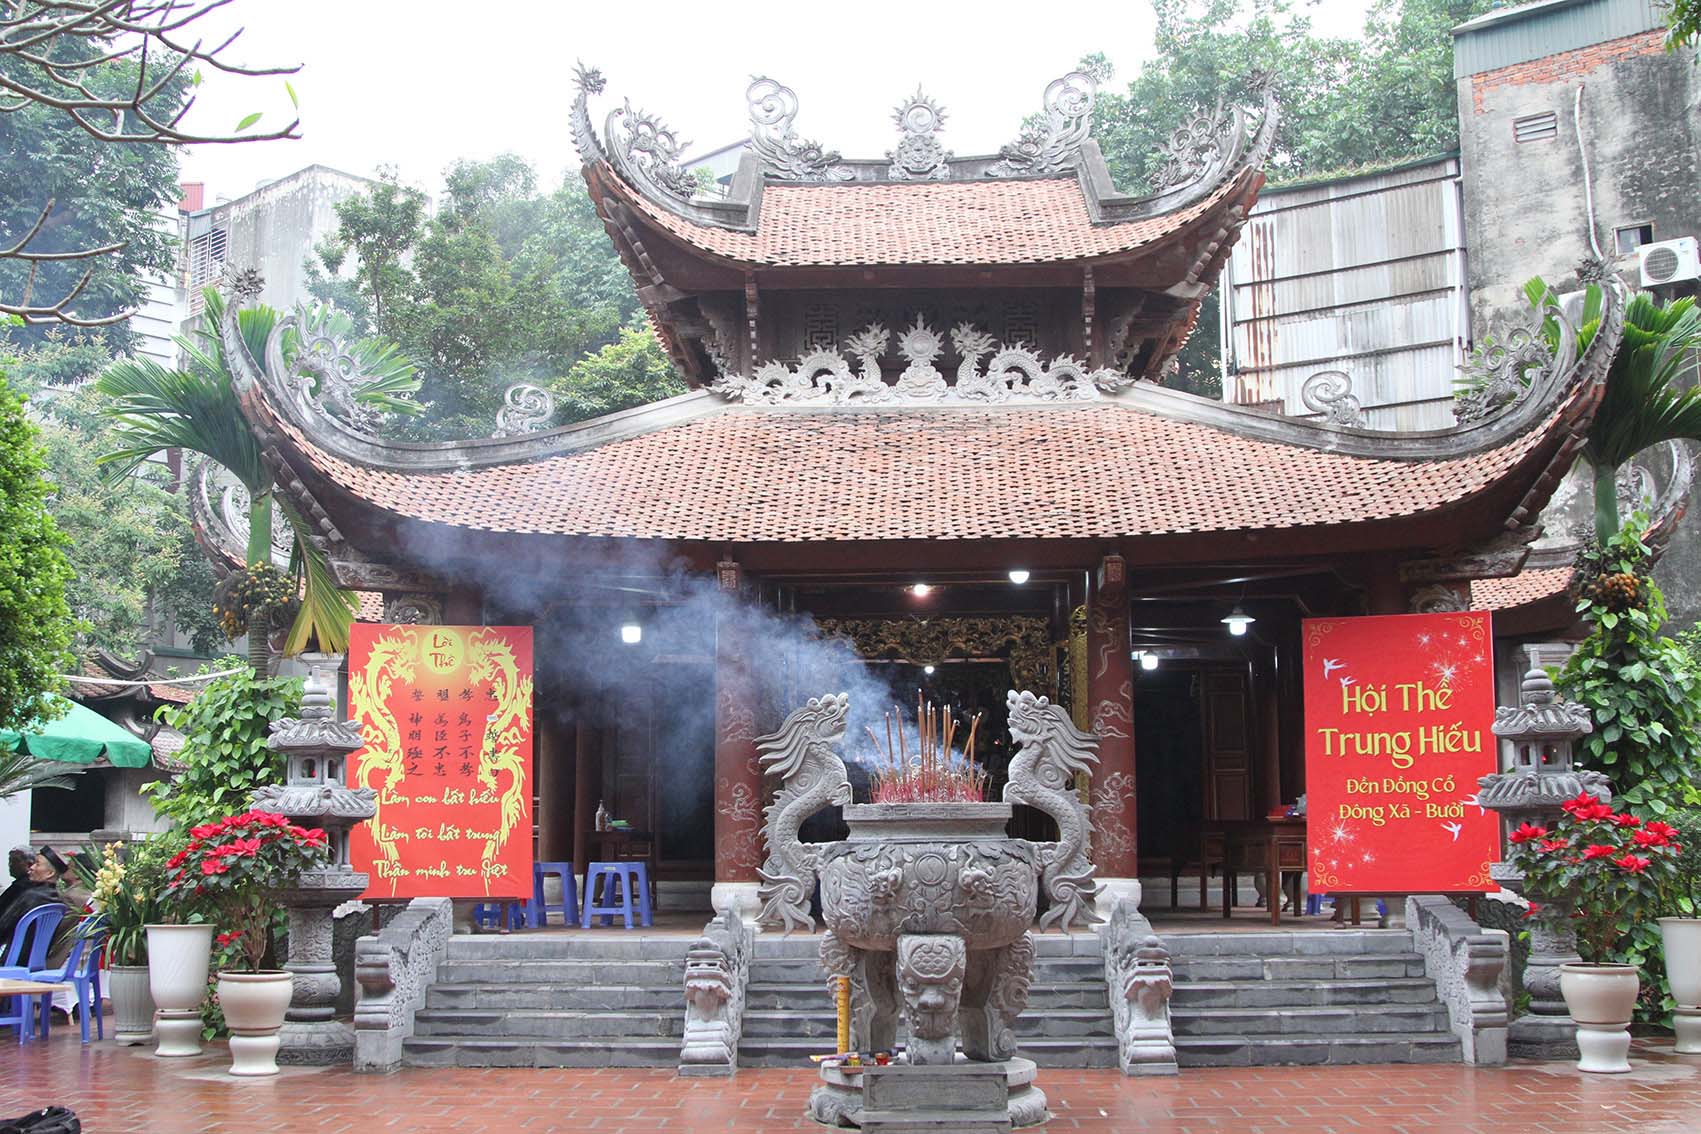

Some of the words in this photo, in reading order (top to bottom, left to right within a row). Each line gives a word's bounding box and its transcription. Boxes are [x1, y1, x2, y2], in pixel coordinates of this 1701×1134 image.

[1341, 682, 1387, 717] Hội
[1395, 677, 1453, 713] Thề
[1317, 727, 1415, 769] Trung
[1418, 720, 1482, 756] Hiếu
[381, 786, 410, 808] Làm
[415, 794, 438, 804] con
[441, 786, 465, 806] bất
[1346, 777, 1379, 795] Đền
[1383, 775, 1430, 800] Đồng
[1431, 774, 1456, 794] Cổ
[1338, 802, 1386, 827] Đông
[1389, 802, 1411, 819] Xã
[1425, 801, 1465, 820] Bưởi
[380, 823, 409, 844] Làm
[415, 827, 433, 840] tôi
[437, 822, 461, 841] bất
[465, 828, 501, 855] trung
[372, 859, 410, 879] Thần
[415, 859, 452, 880] minh
[456, 863, 478, 877] tru
